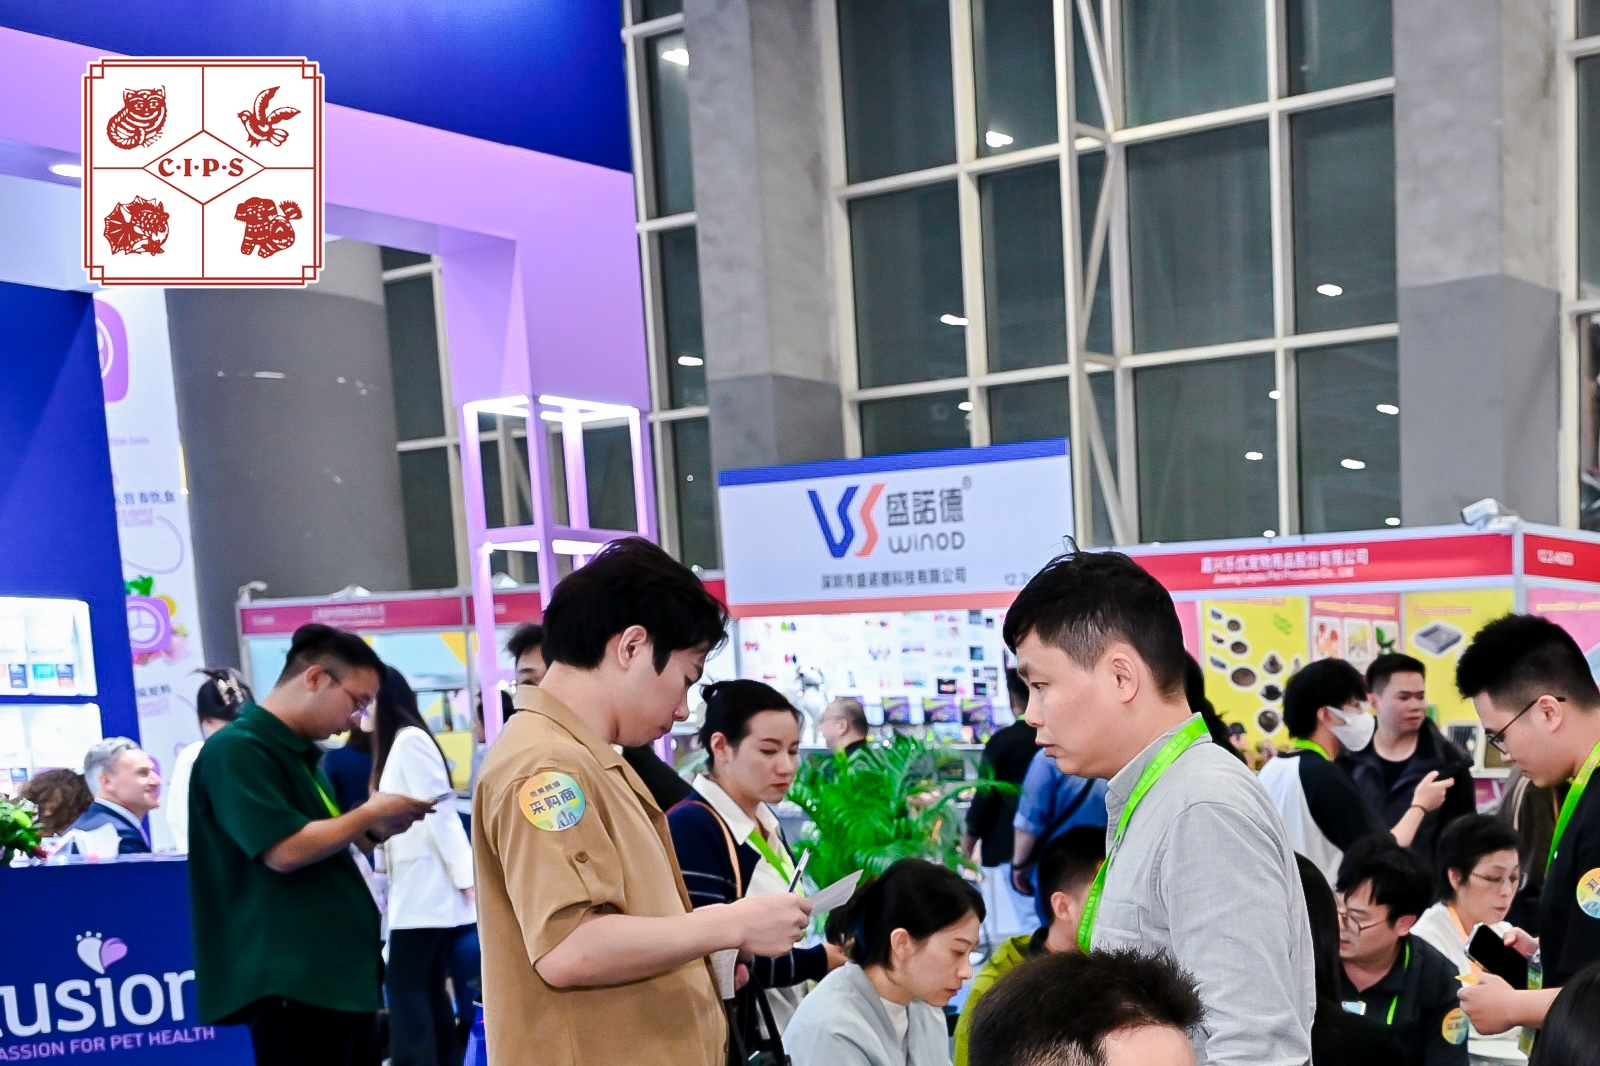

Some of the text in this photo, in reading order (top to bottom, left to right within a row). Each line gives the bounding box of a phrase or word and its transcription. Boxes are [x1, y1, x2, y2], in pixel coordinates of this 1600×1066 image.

[528, 787, 577, 816] 采购商
[70, 1035, 106, 1055] FOR
[110, 1032, 144, 1051] PET
[149, 1025, 216, 1046] HEALTH
